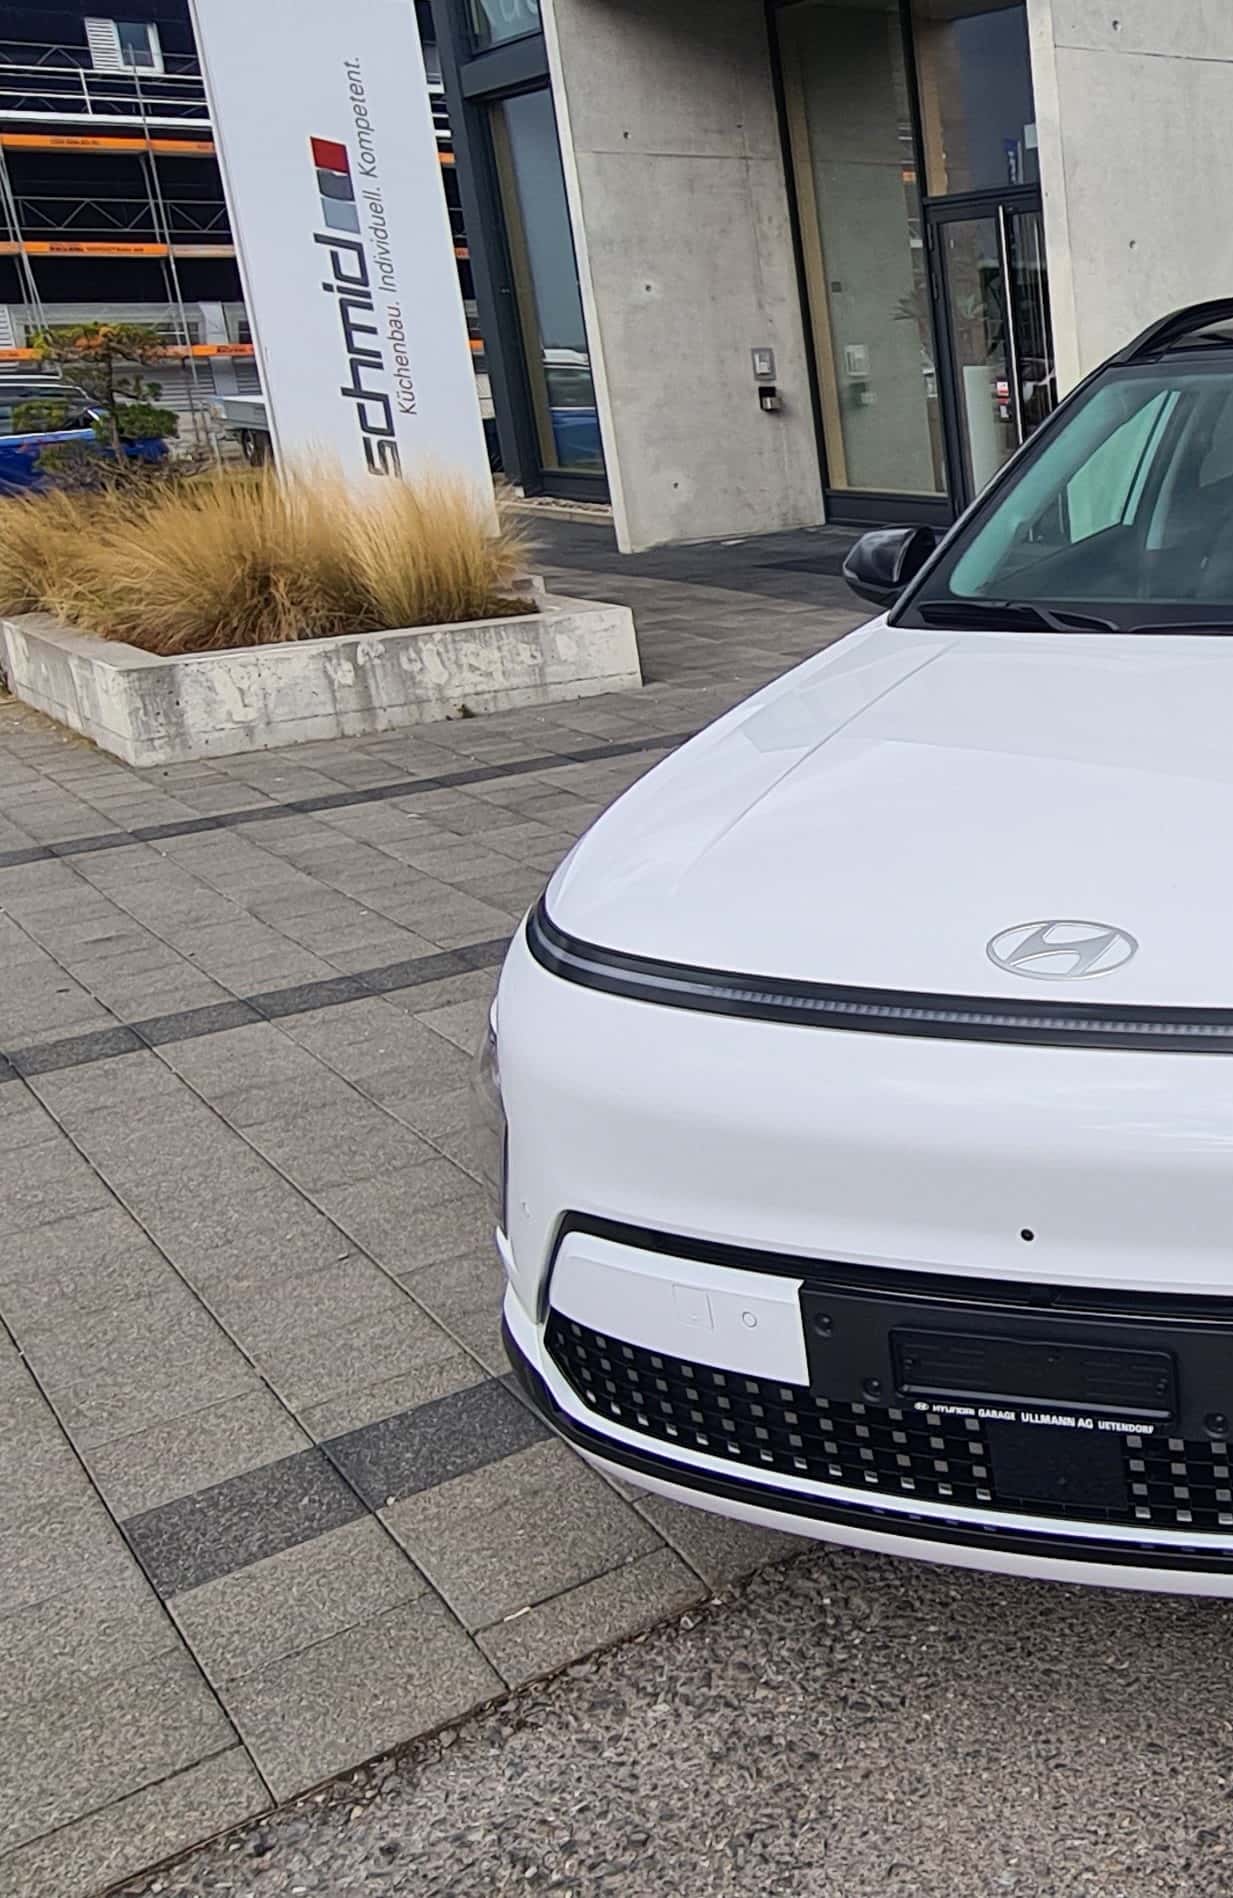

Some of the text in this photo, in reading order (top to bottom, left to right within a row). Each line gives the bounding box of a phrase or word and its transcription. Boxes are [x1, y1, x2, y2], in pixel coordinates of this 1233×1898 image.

[313, 232, 401, 479] schmid
[344, 57, 417, 415] Küchenbau. Individuell. Kompetent.
[978, 1408, 1016, 1421] GARAGE
[1021, 1412, 1075, 1427] ULLMANN
[1077, 1418, 1094, 1429] AG
[1098, 1420, 1154, 1434] UETENDORF
